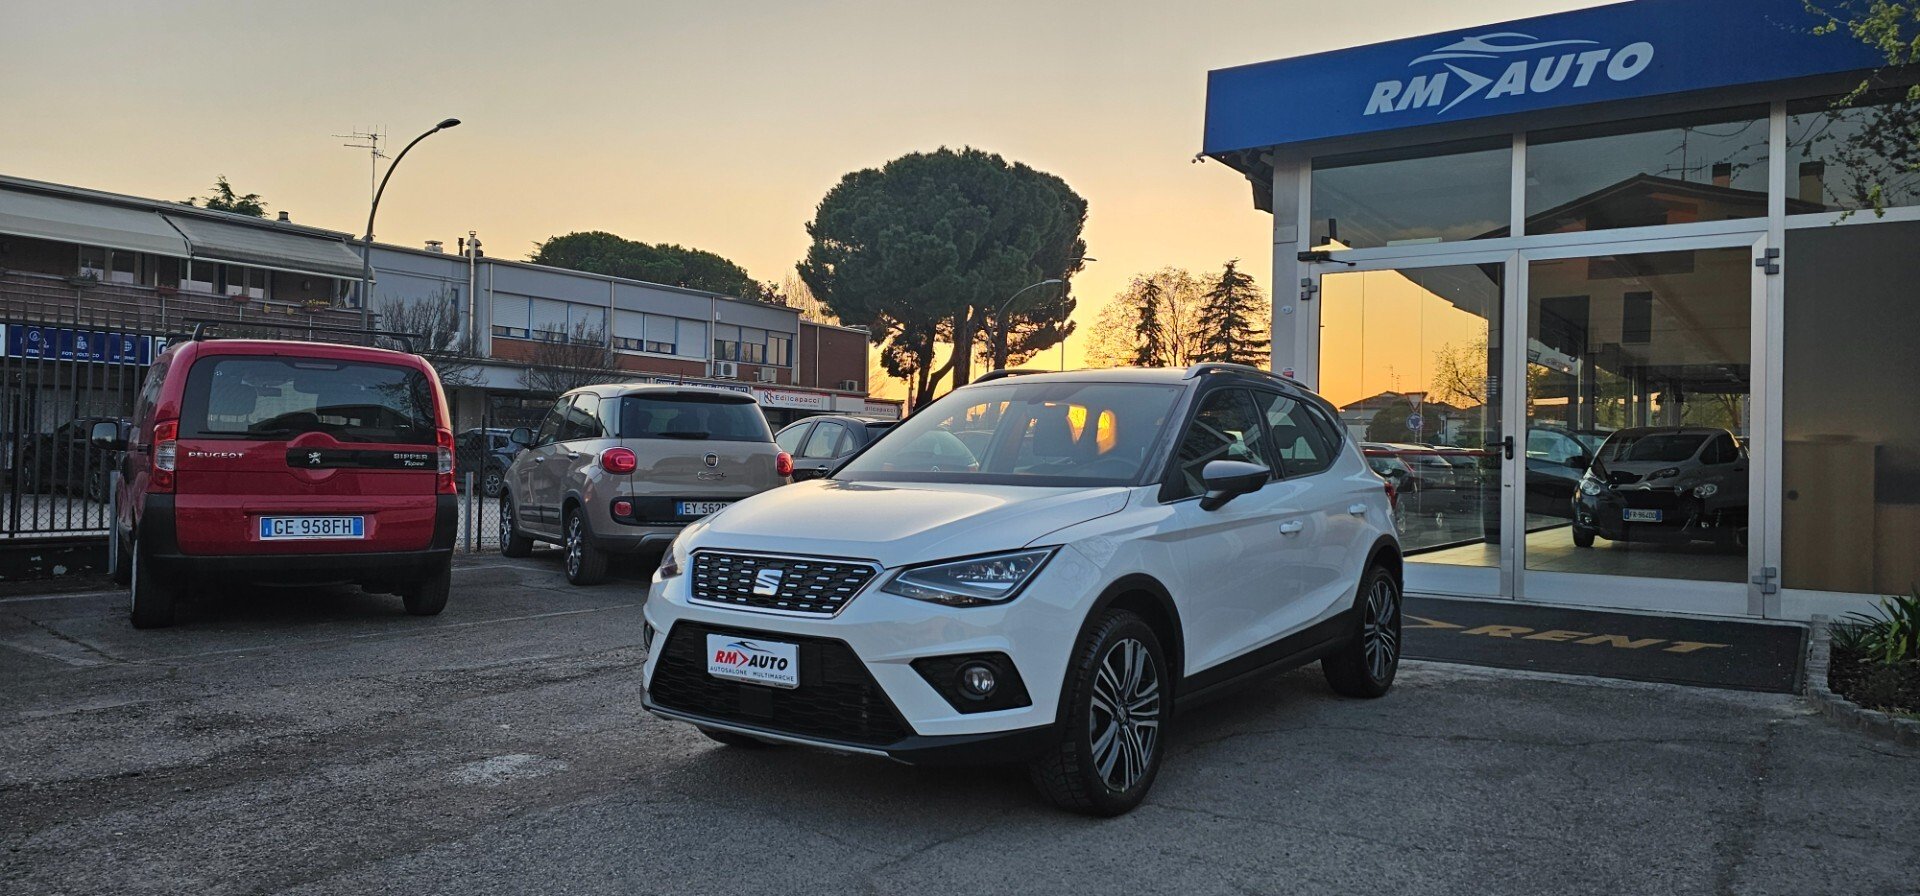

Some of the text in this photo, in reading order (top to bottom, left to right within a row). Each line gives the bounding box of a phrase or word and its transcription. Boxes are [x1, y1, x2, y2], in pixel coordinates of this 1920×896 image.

[1363, 41, 1655, 116] RM AUTO
[775, 396, 820, 404] Edilcapacci
[188, 451, 244, 459] PEUGEOT
[684, 503, 697, 514] EY
[274, 519, 352, 534] GE 958FH
[1460, 624, 1730, 653] RENT
[715, 649, 788, 671] RM AUTO
[709, 666, 748, 676] AUTOSALONE
[753, 671, 794, 682] MULTIMARCHE
